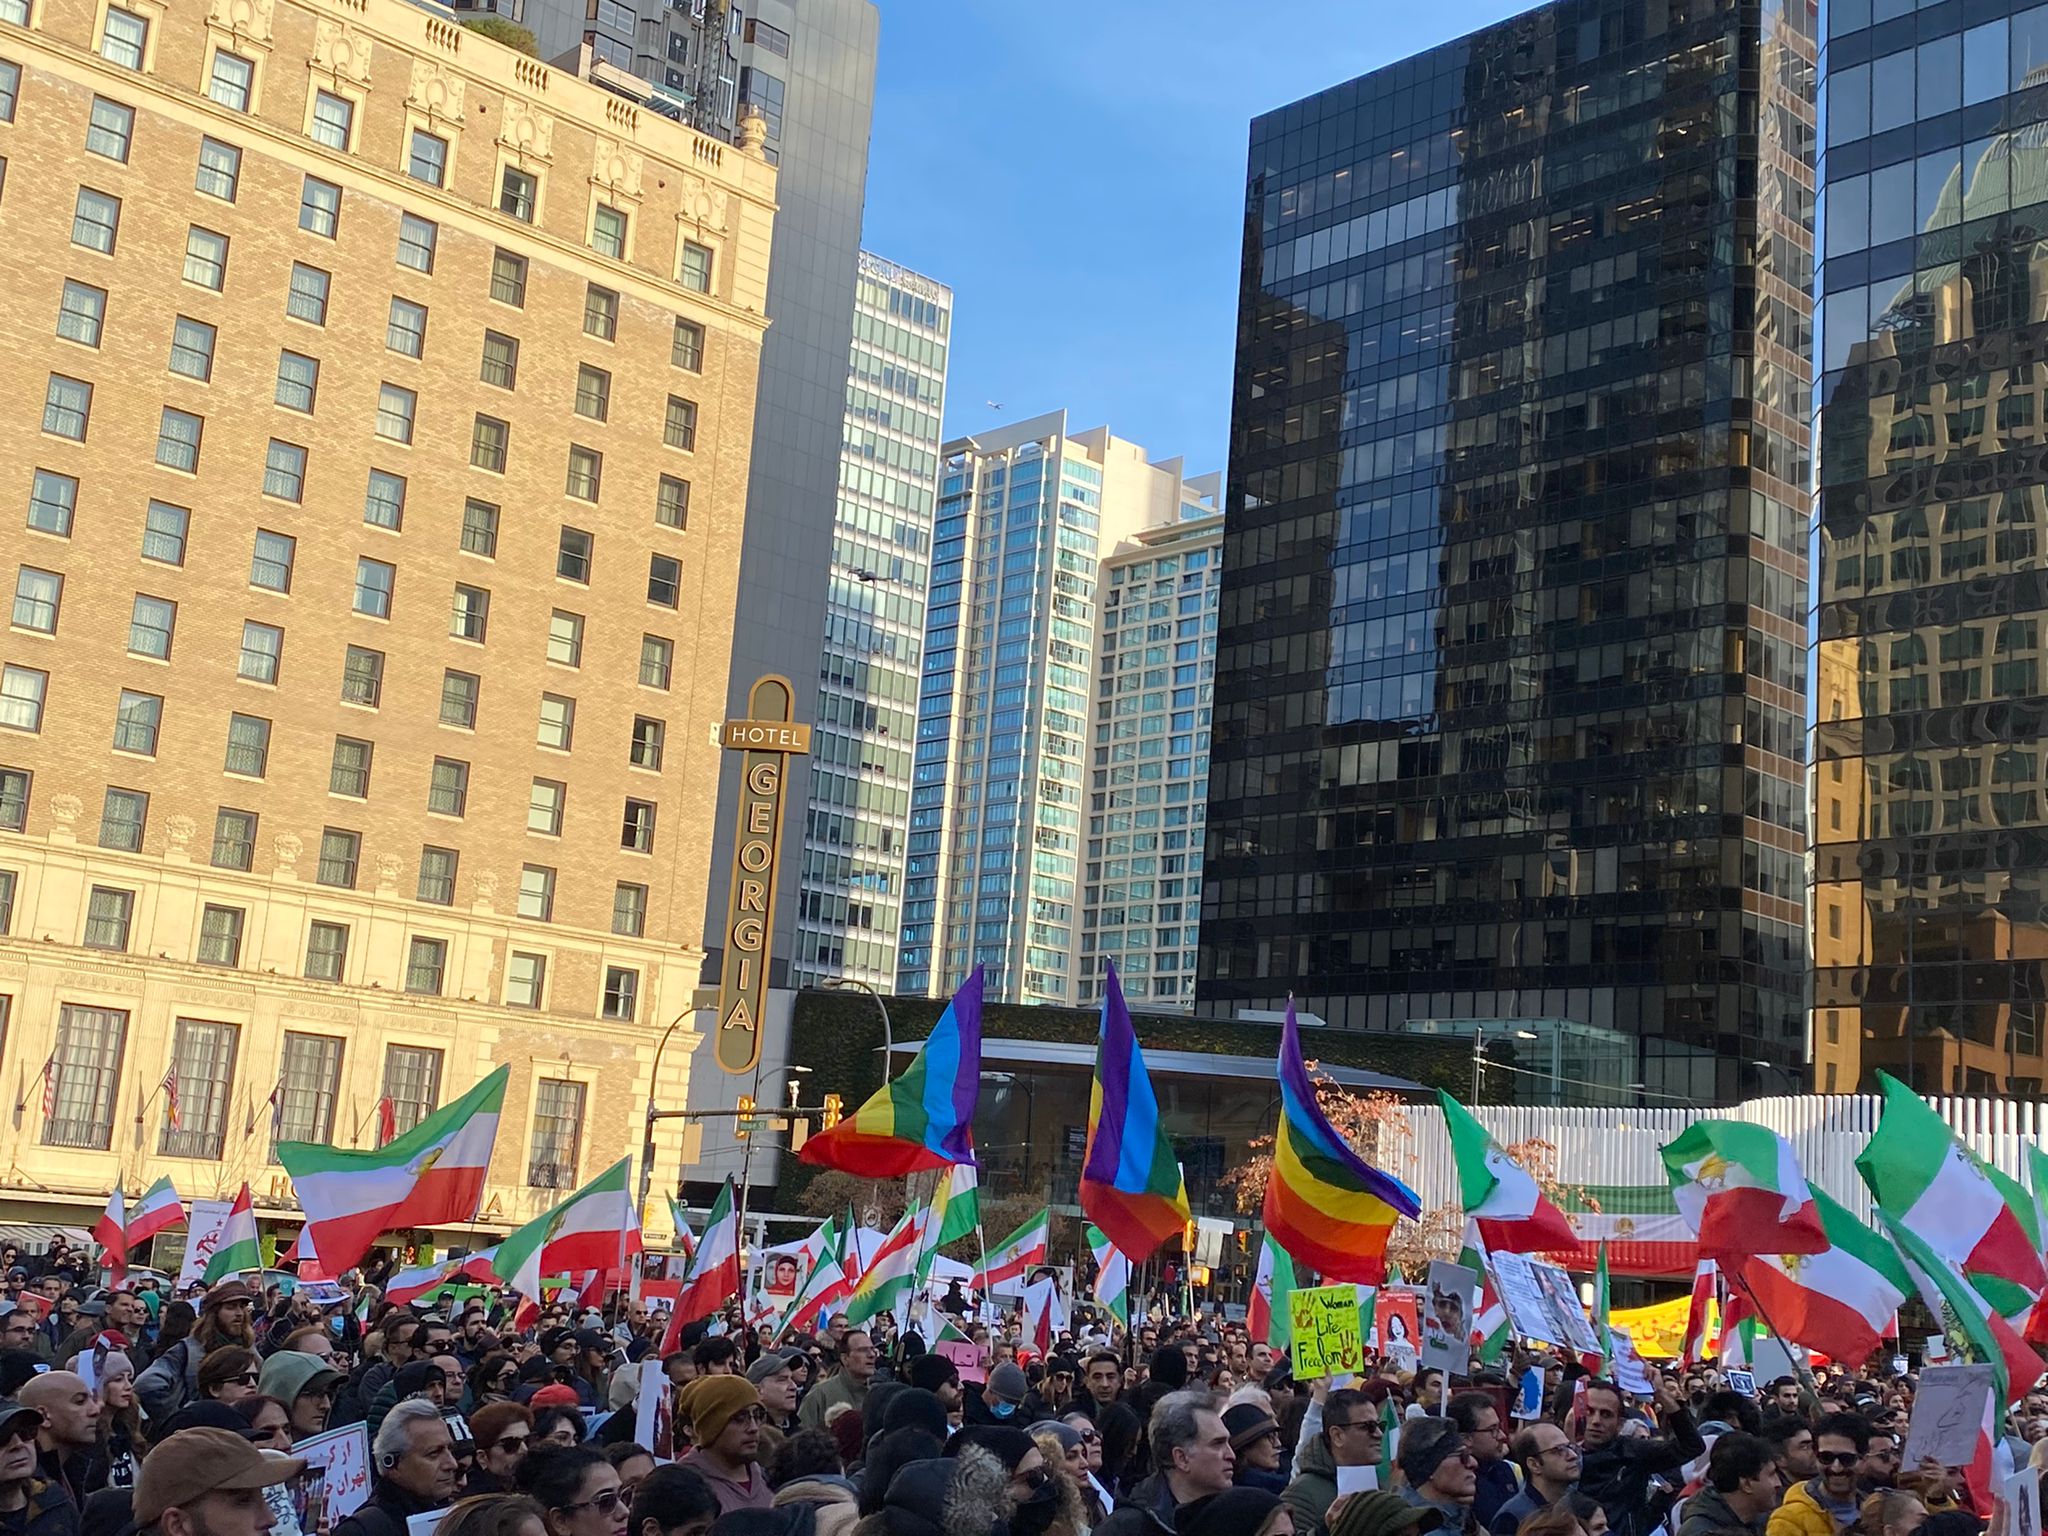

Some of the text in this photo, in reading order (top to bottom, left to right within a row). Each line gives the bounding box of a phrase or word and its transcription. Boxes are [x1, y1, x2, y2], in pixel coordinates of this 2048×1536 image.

[732, 726, 802, 747] HOTEL
[724, 762, 779, 1031] GEORGIA
[1319, 1293, 1355, 1310] Woman
[1315, 1313, 1341, 1337] Life
